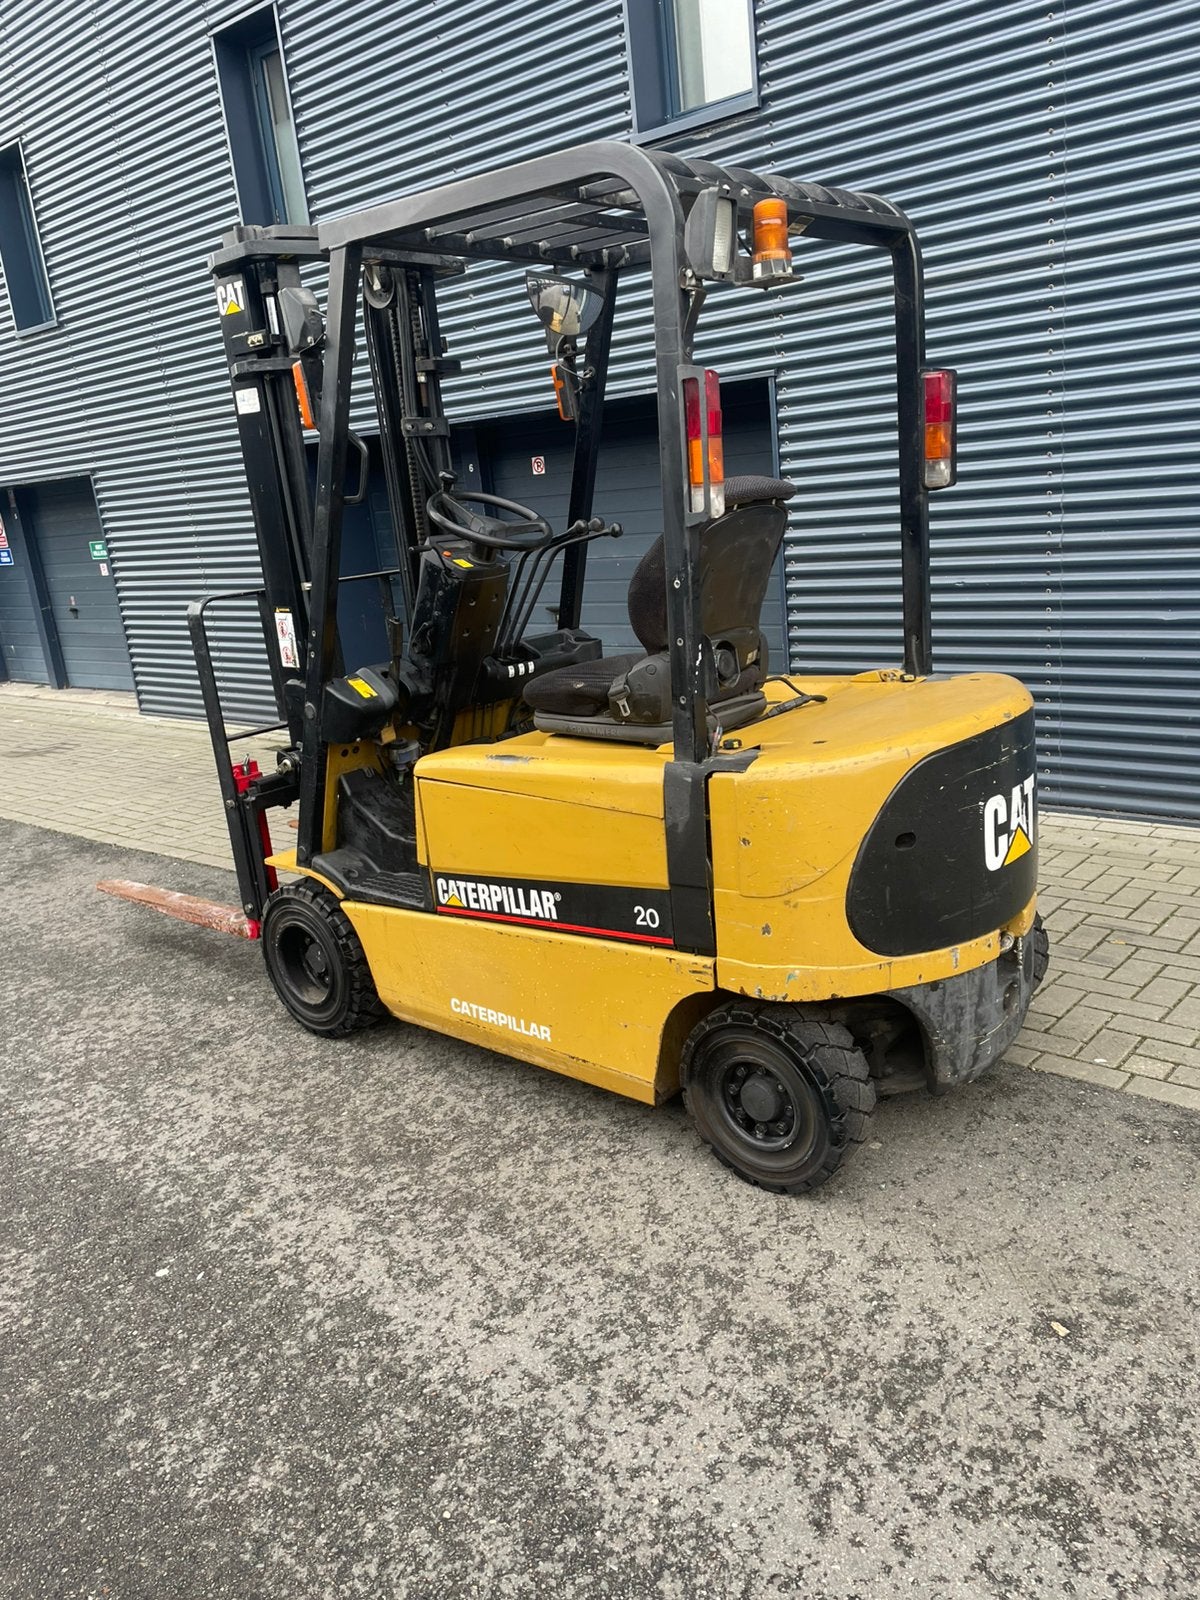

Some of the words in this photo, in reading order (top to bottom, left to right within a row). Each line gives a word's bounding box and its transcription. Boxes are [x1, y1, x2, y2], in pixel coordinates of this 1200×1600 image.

[216, 280, 245, 316] CAT
[468, 463, 474, 473] 6
[984, 773, 1034, 871] CAT
[634, 905, 660, 928] 20
[450, 997, 552, 1042] CATERPILLAR
